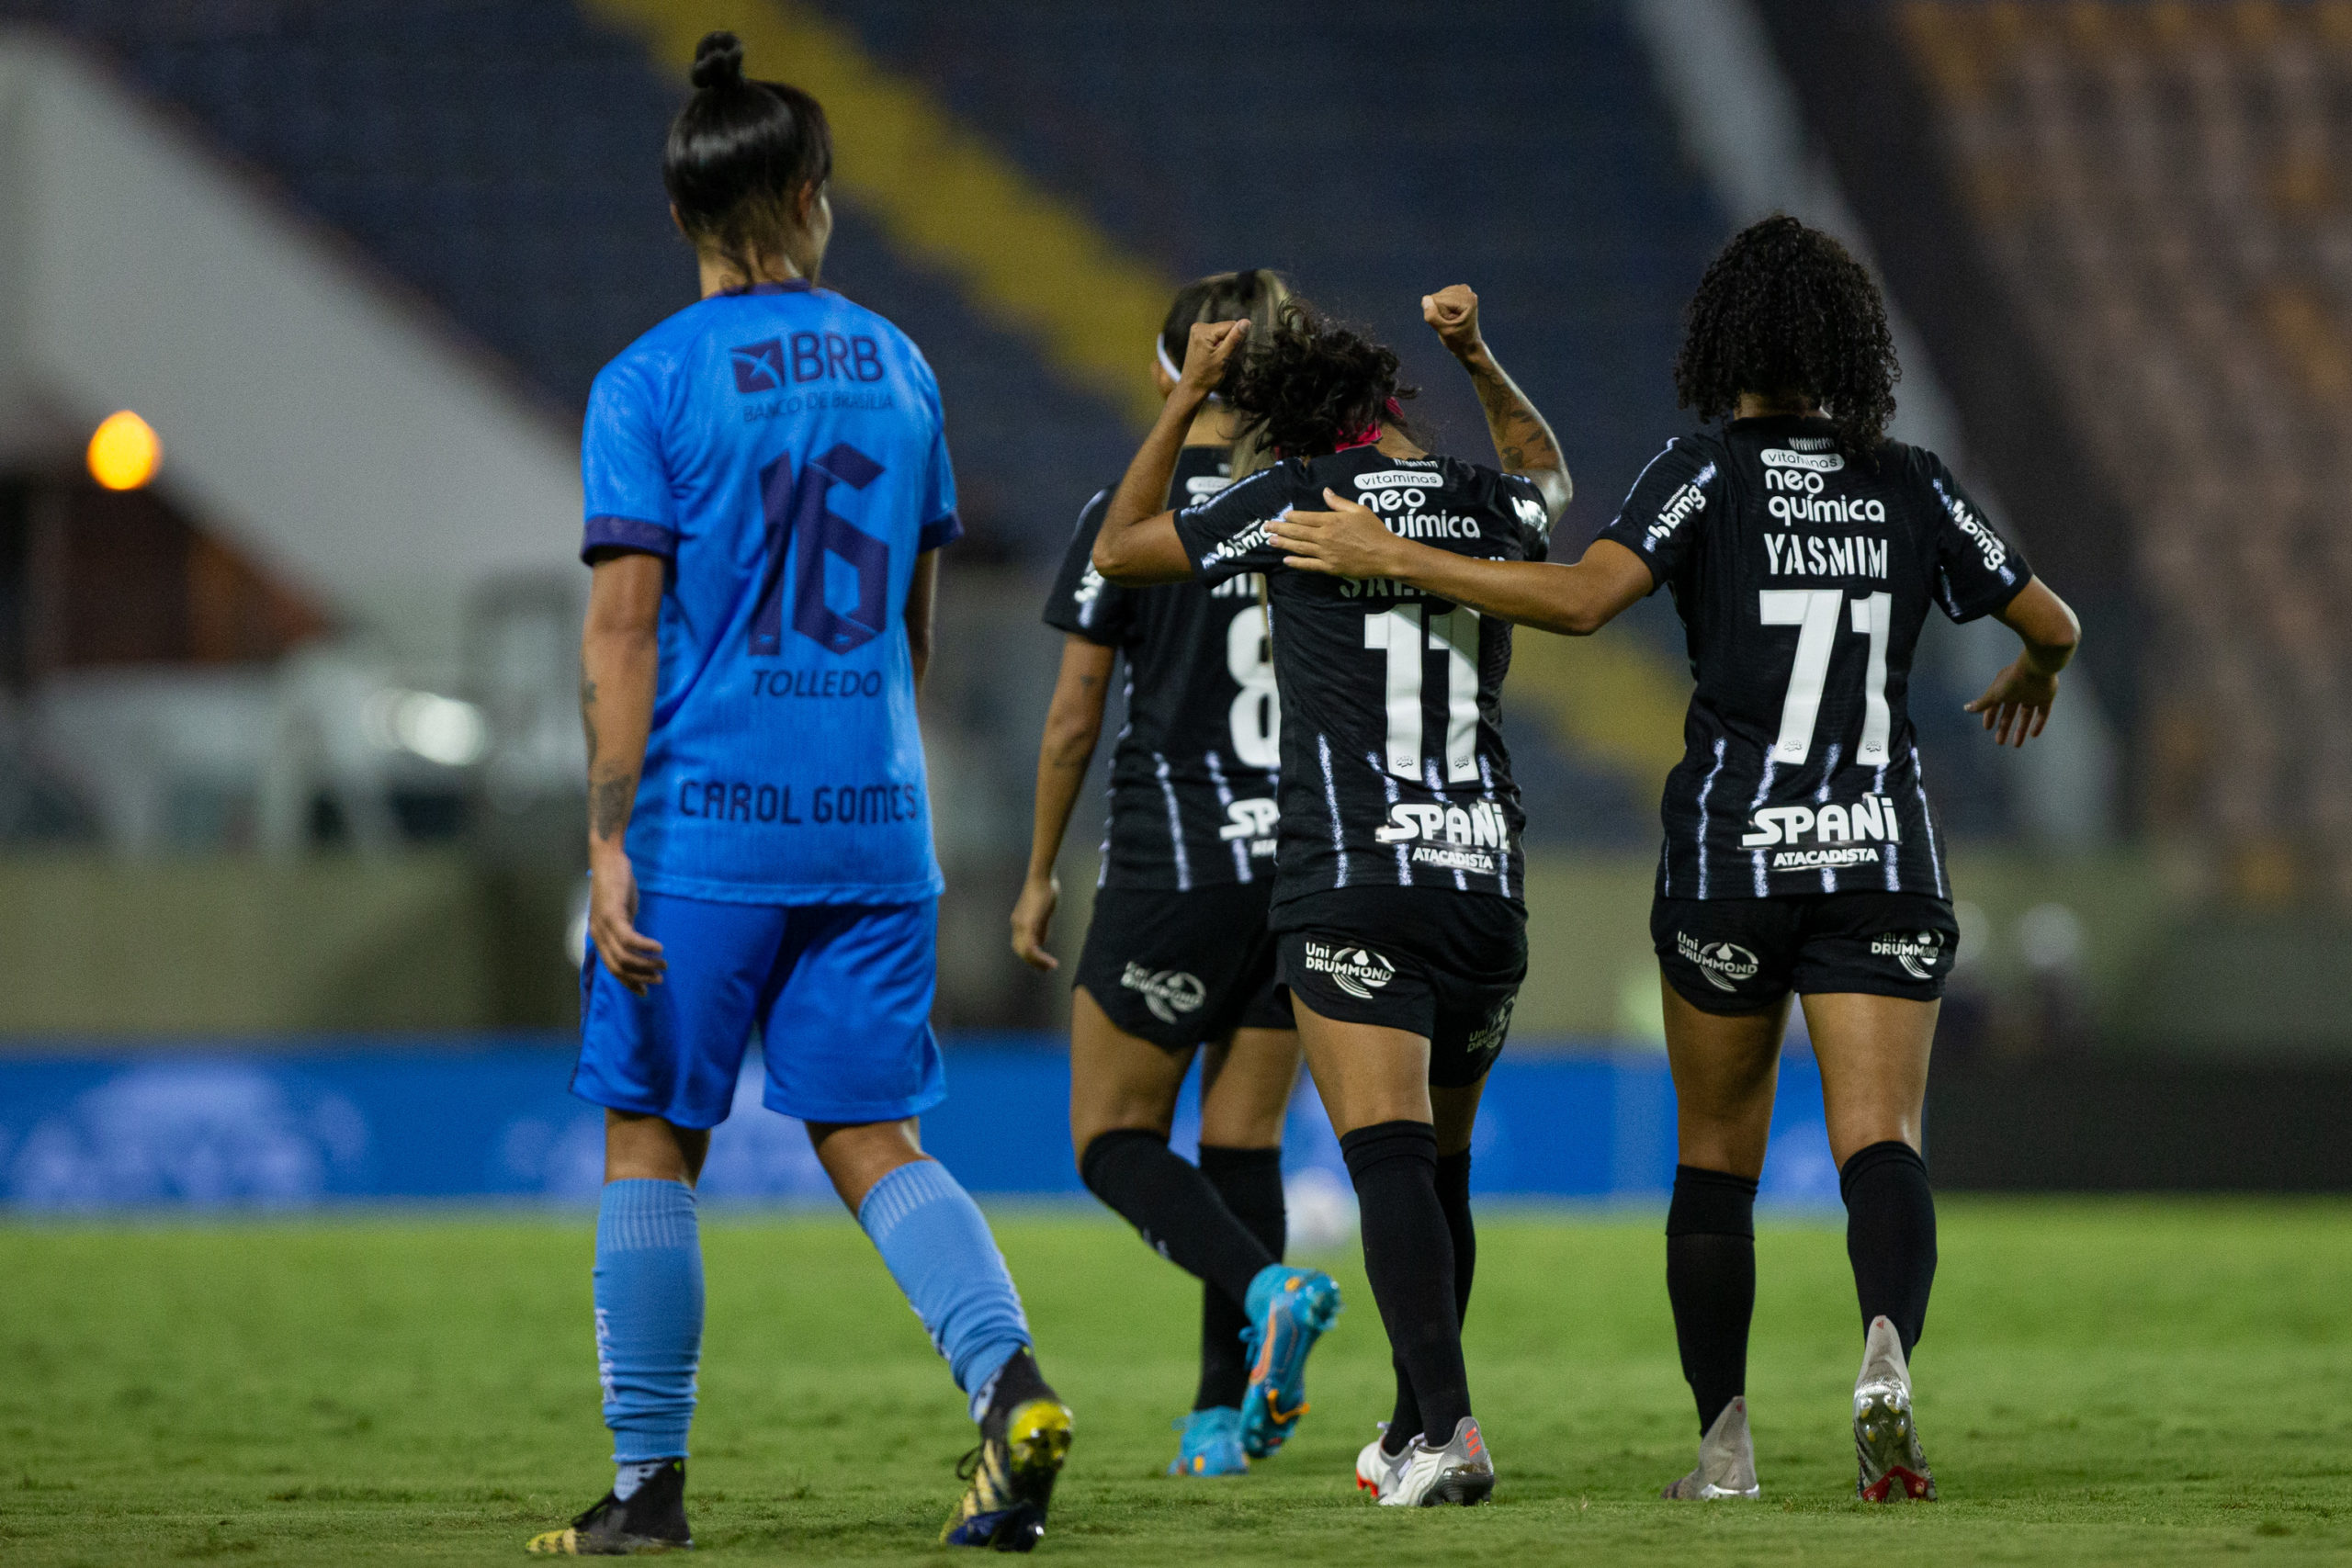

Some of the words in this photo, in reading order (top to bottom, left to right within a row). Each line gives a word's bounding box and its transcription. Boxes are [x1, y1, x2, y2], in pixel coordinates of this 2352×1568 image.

[788, 331, 885, 384] BRB
[743, 396, 802, 423] BANCO
[807, 392, 829, 410] DE
[1768, 451, 1838, 469] vitaminas
[1361, 472, 1438, 486] vitaminas
[1764, 468, 1825, 494] neo
[1357, 488, 1426, 513] neo
[1657, 484, 1706, 530] bmg
[1768, 493, 1886, 527] química
[1385, 508, 1481, 538] uímica
[748, 442, 889, 657] 16
[1763, 533, 1888, 580] YASMIM
[1959, 513, 2006, 571] bmg
[751, 669, 882, 698] TOLLEDO
[1226, 604, 1282, 769] 8
[1758, 589, 1893, 766] 71
[1364, 604, 1481, 784] 11
[679, 779, 802, 825] CAROL
[812, 782, 917, 825] GOMES
[1411, 846, 1495, 871] ATACADISTA
[1773, 846, 1880, 868] ATACADISTA
[1306, 942, 1330, 958] Uni
[1677, 930, 1699, 951] Uni
[1306, 956, 1393, 981] DRUMMOND
[1678, 942, 1758, 975] DRUMMOND
